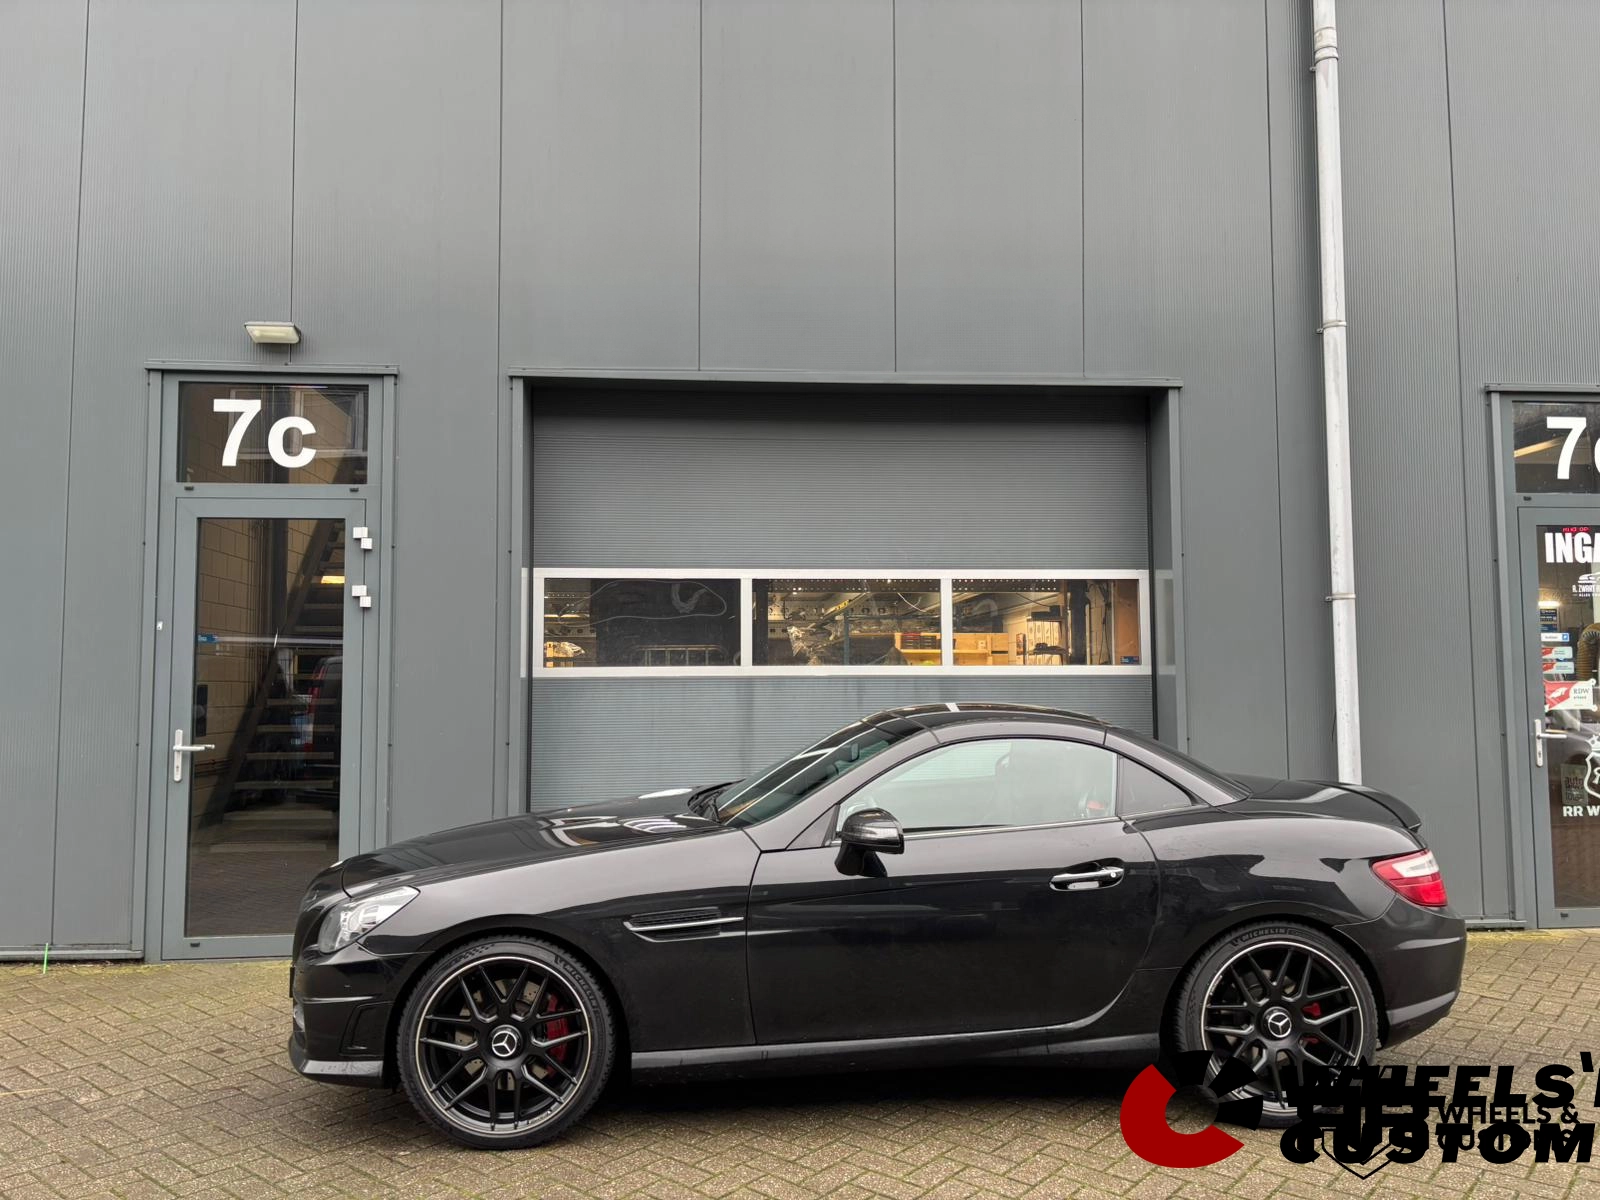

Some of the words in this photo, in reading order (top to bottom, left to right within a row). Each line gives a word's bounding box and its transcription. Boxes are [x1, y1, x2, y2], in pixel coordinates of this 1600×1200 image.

[213, 398, 317, 468] 7c
[1546, 416, 1600, 480] 7
[1563, 805, 1583, 817] RR
[1241, 928, 1286, 942] MICHELIN
[564, 963, 598, 1008] MICHELIN
